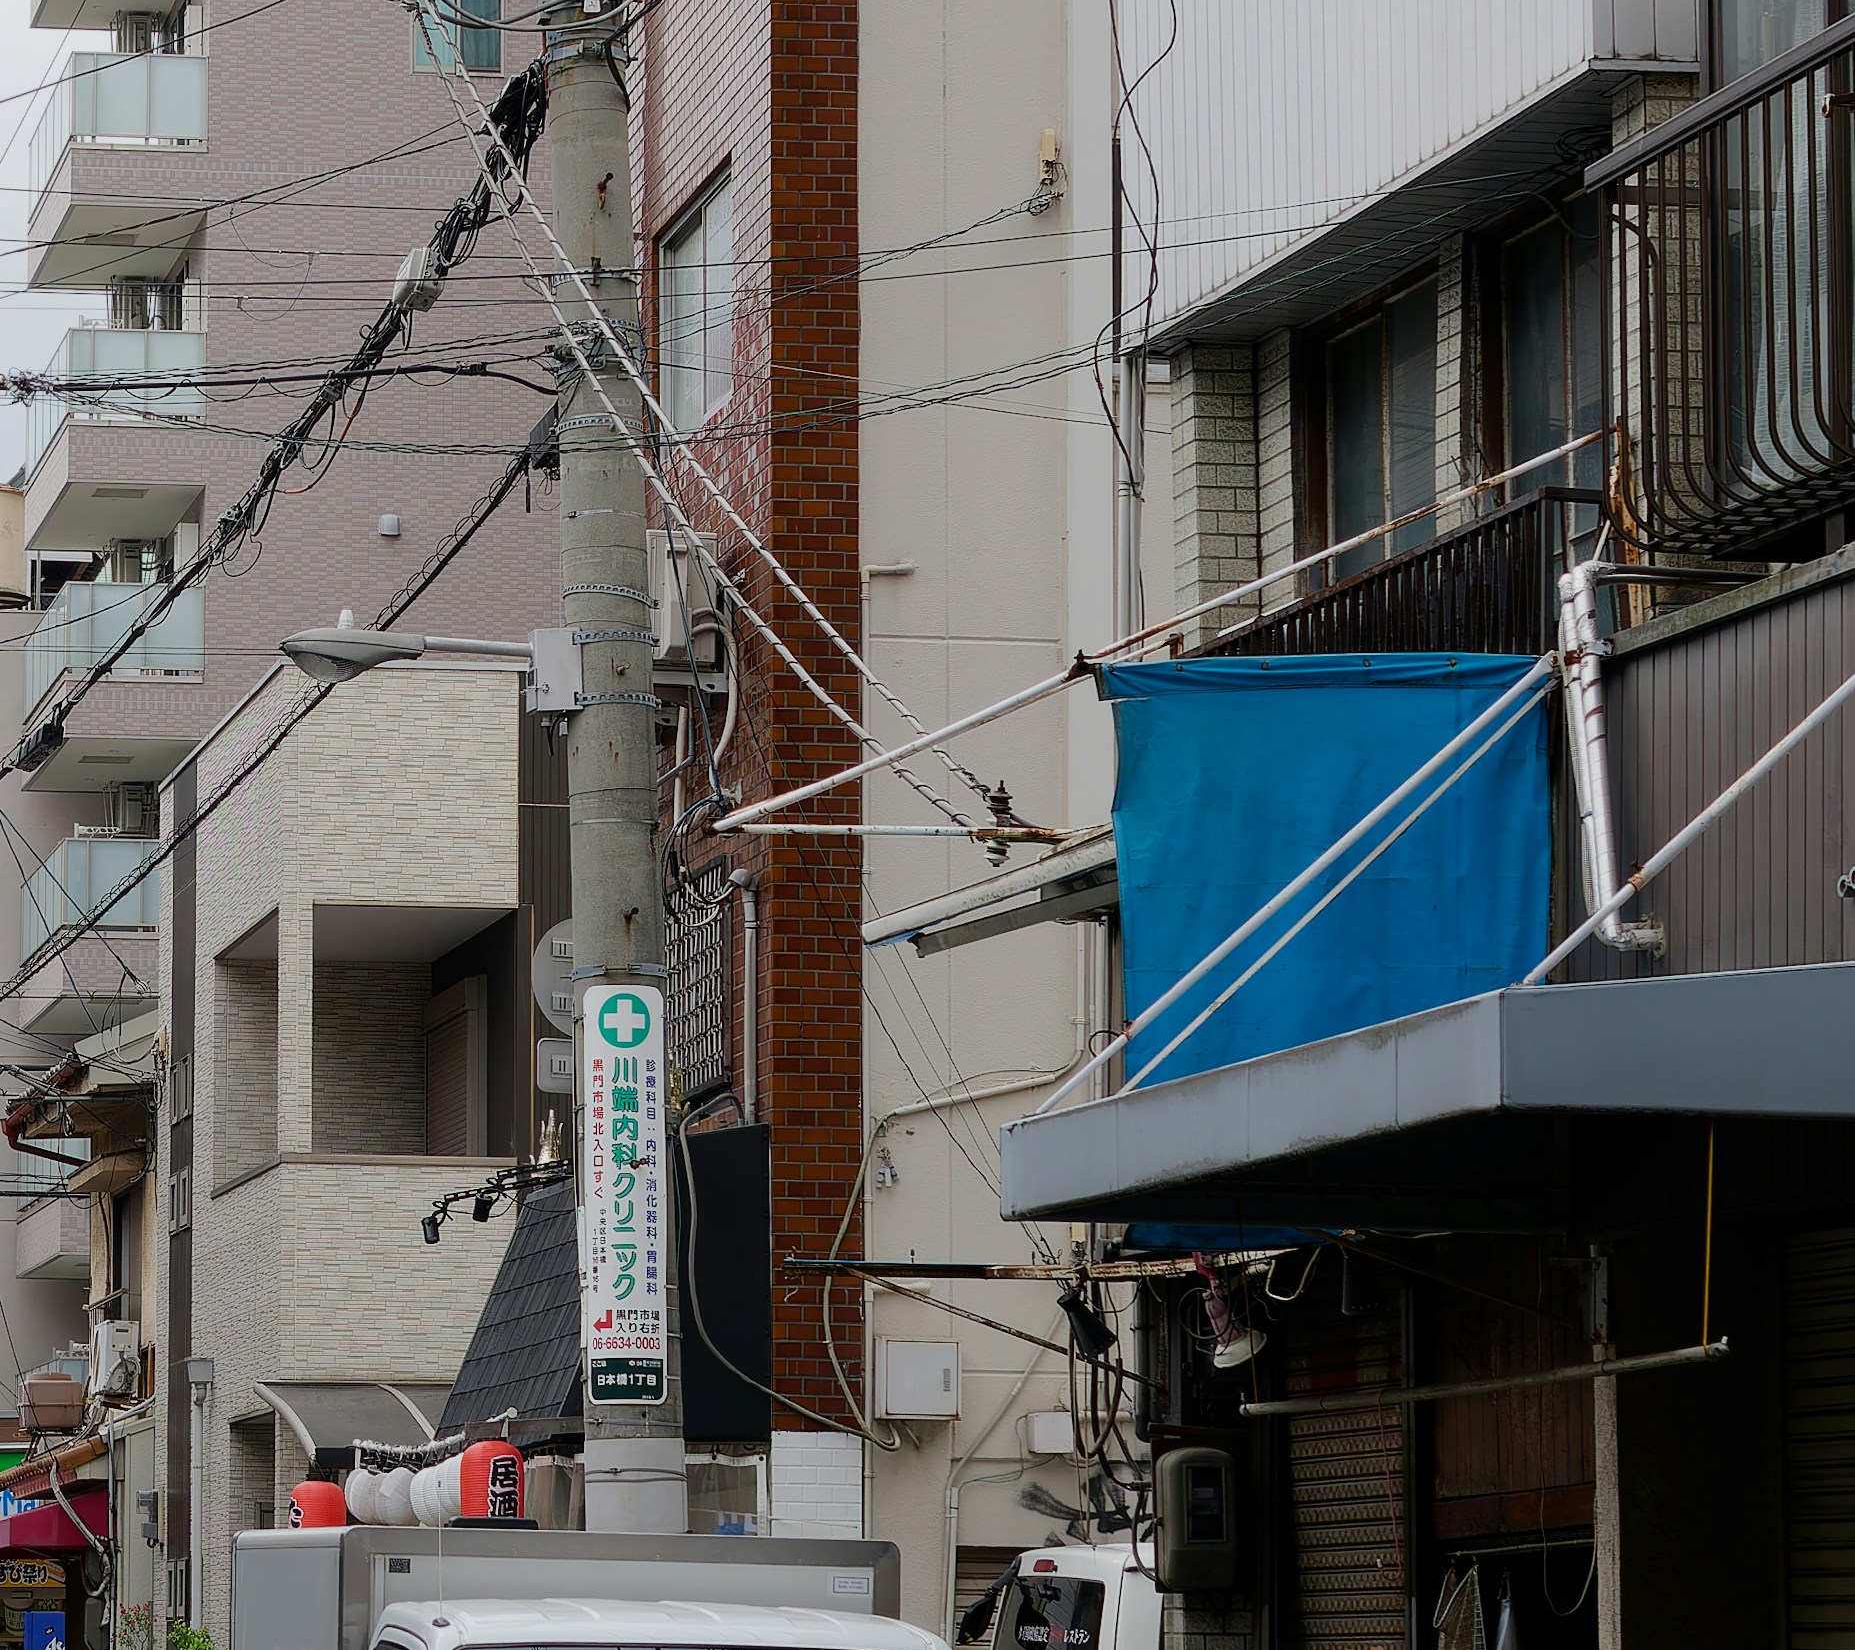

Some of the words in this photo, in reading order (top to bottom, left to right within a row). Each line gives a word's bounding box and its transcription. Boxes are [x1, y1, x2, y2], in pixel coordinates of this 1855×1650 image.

[592, 1058, 604, 1199] 黒門市場北入口すぐ
[611, 1056, 639, 1301] 川端内科クリニック
[616, 1309, 660, 1321] 黒門市場
[616, 1322, 660, 1334] 入り右折
[593, 1336, 660, 1350] 06-6634-0003
[597, 1373, 657, 1386] 日本橋1丁目
